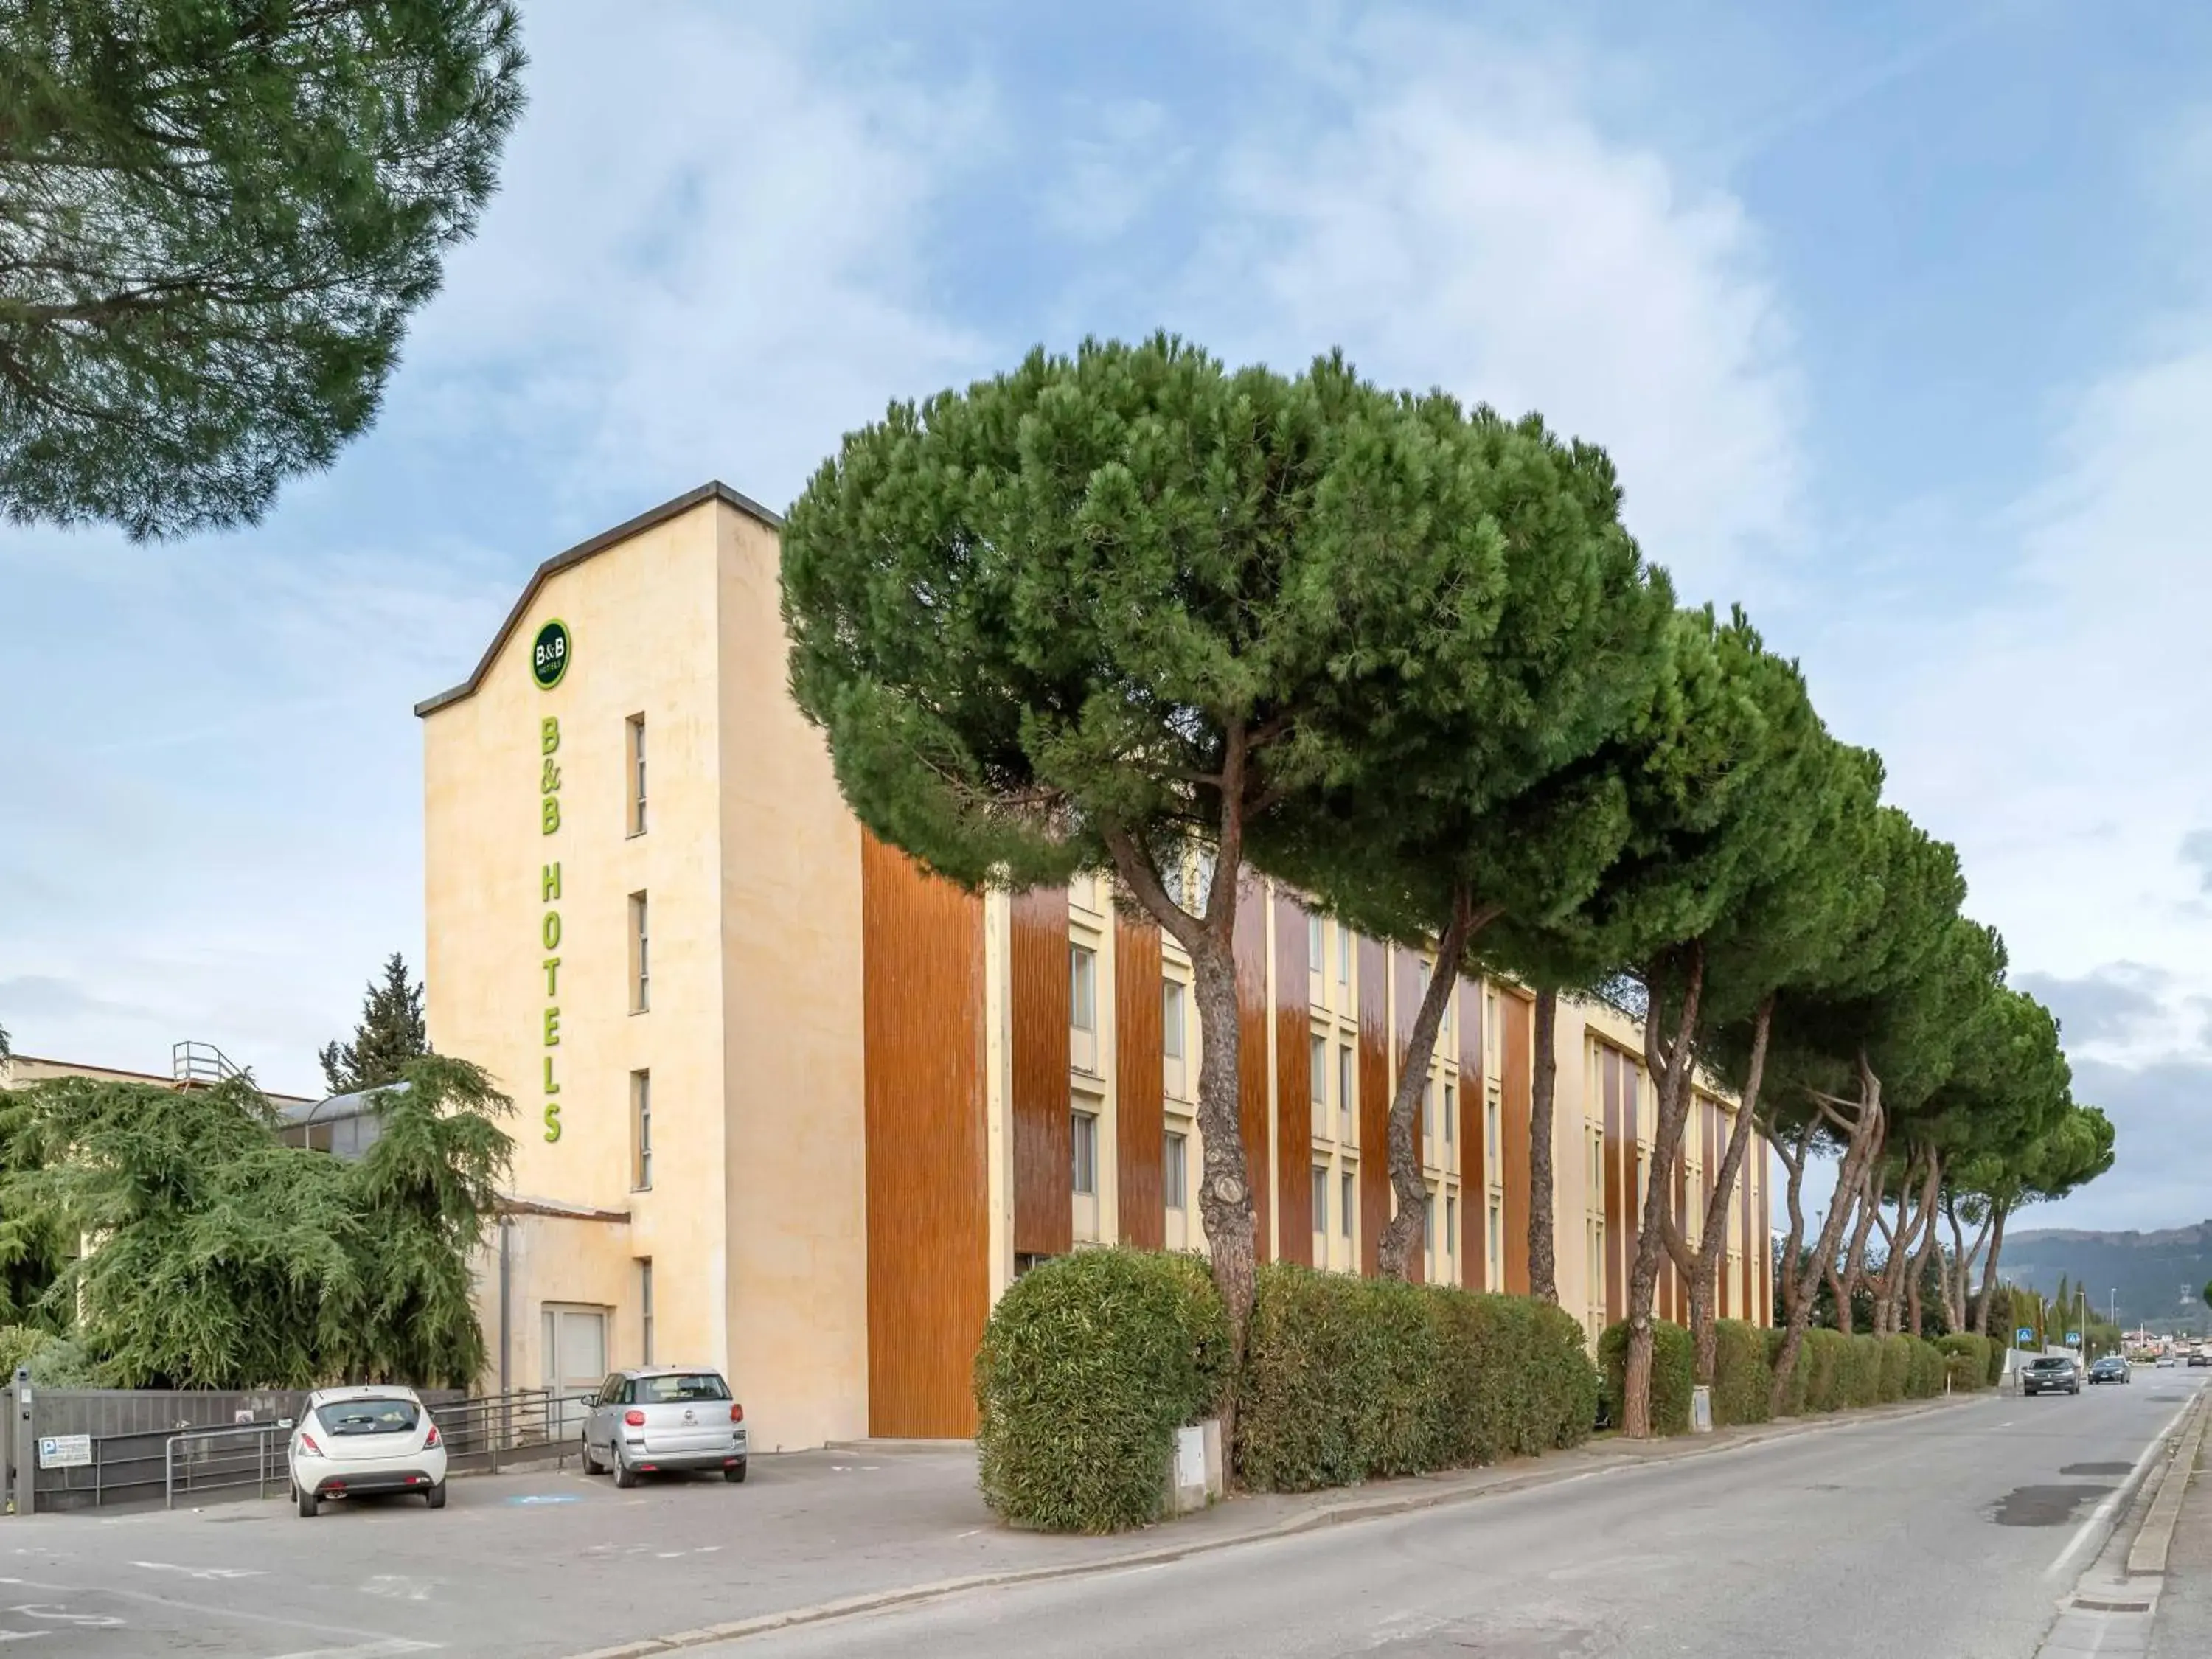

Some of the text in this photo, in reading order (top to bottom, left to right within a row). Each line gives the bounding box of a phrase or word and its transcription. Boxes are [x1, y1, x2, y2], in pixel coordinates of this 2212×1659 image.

[536, 637, 564, 667] B&B
[541, 716, 561, 1143] B&B HOTELS
[44, 1440, 55, 1454] P
